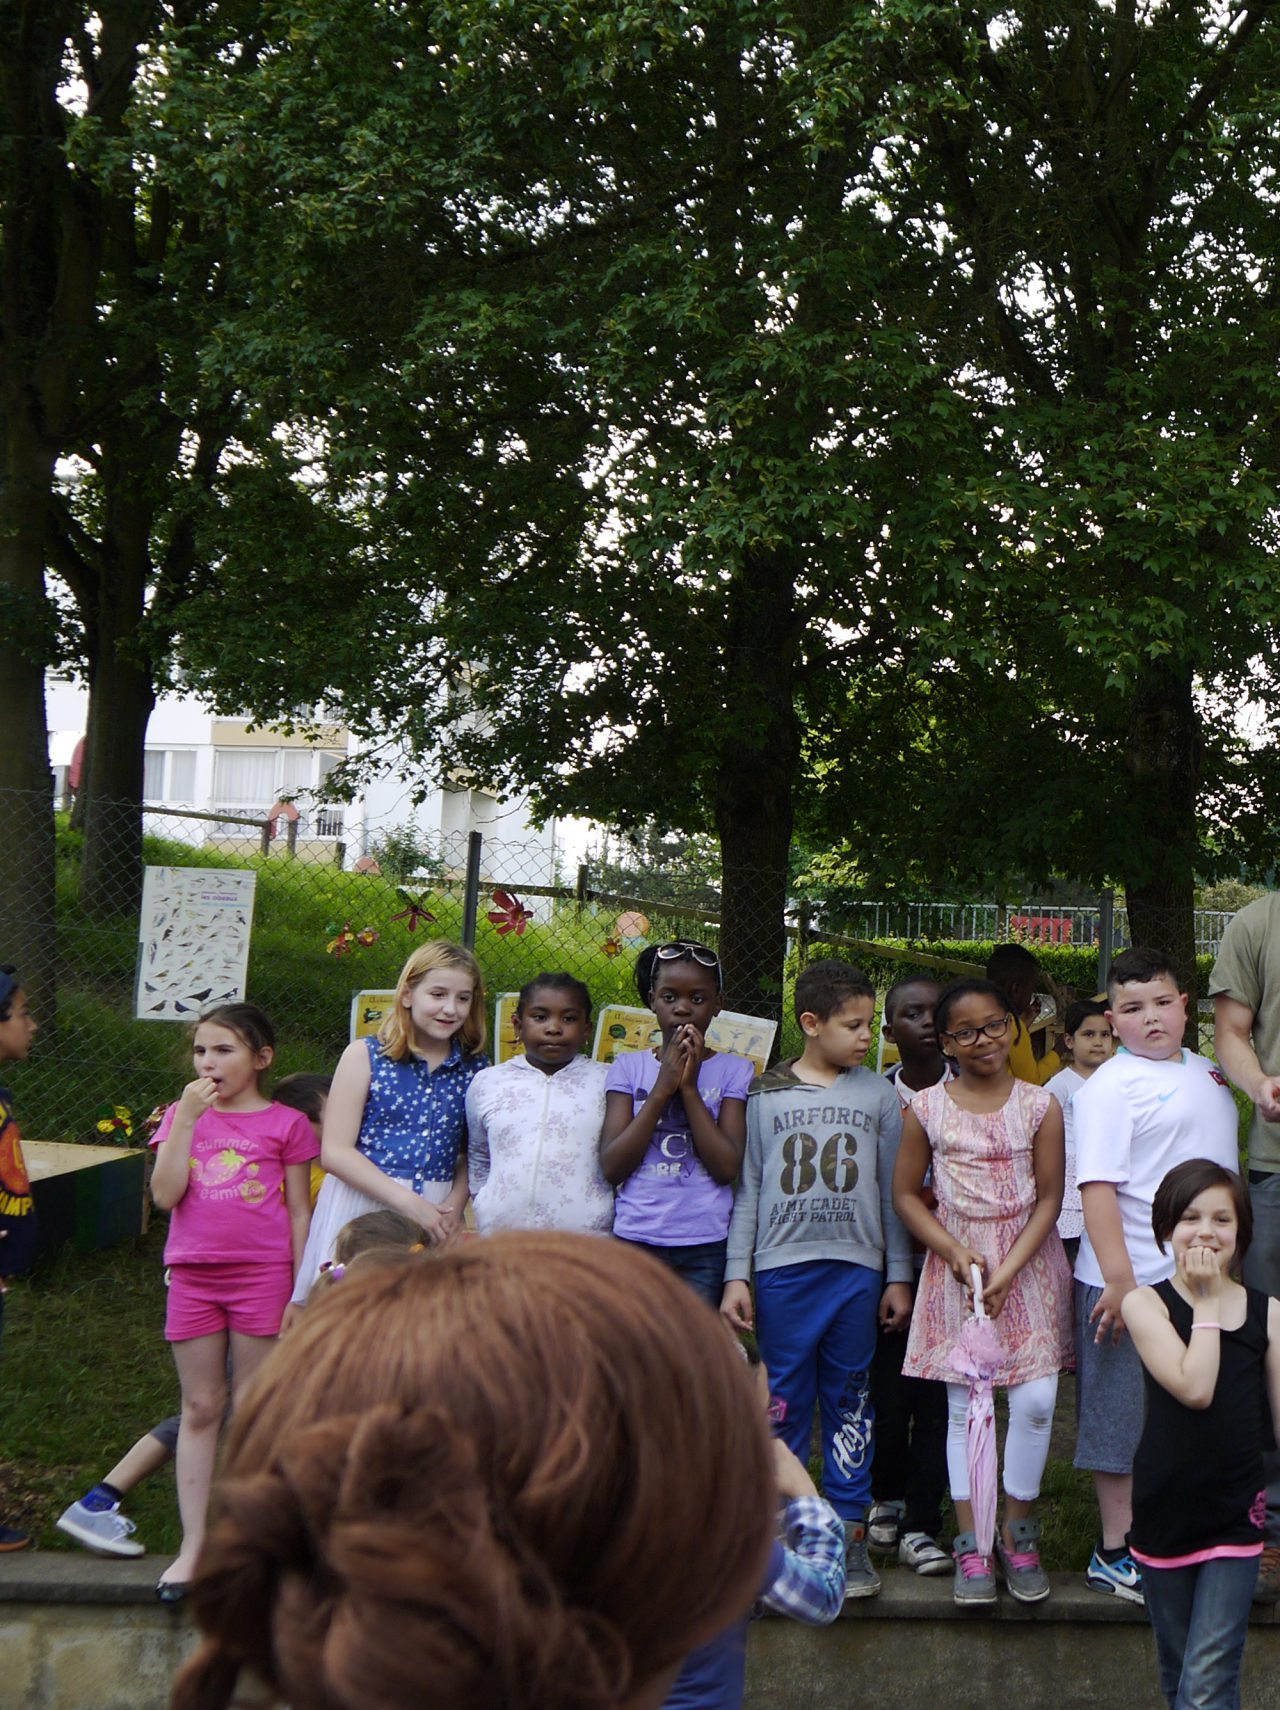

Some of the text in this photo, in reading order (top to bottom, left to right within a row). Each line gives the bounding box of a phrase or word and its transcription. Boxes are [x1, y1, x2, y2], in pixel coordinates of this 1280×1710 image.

[773, 1106, 872, 1135] AIRFORCE
[195, 1137, 259, 1153] summer
[780, 1132, 859, 1195] 86
[810, 1197, 857, 1211] CADET
[809, 1211, 857, 1223] PATROL
